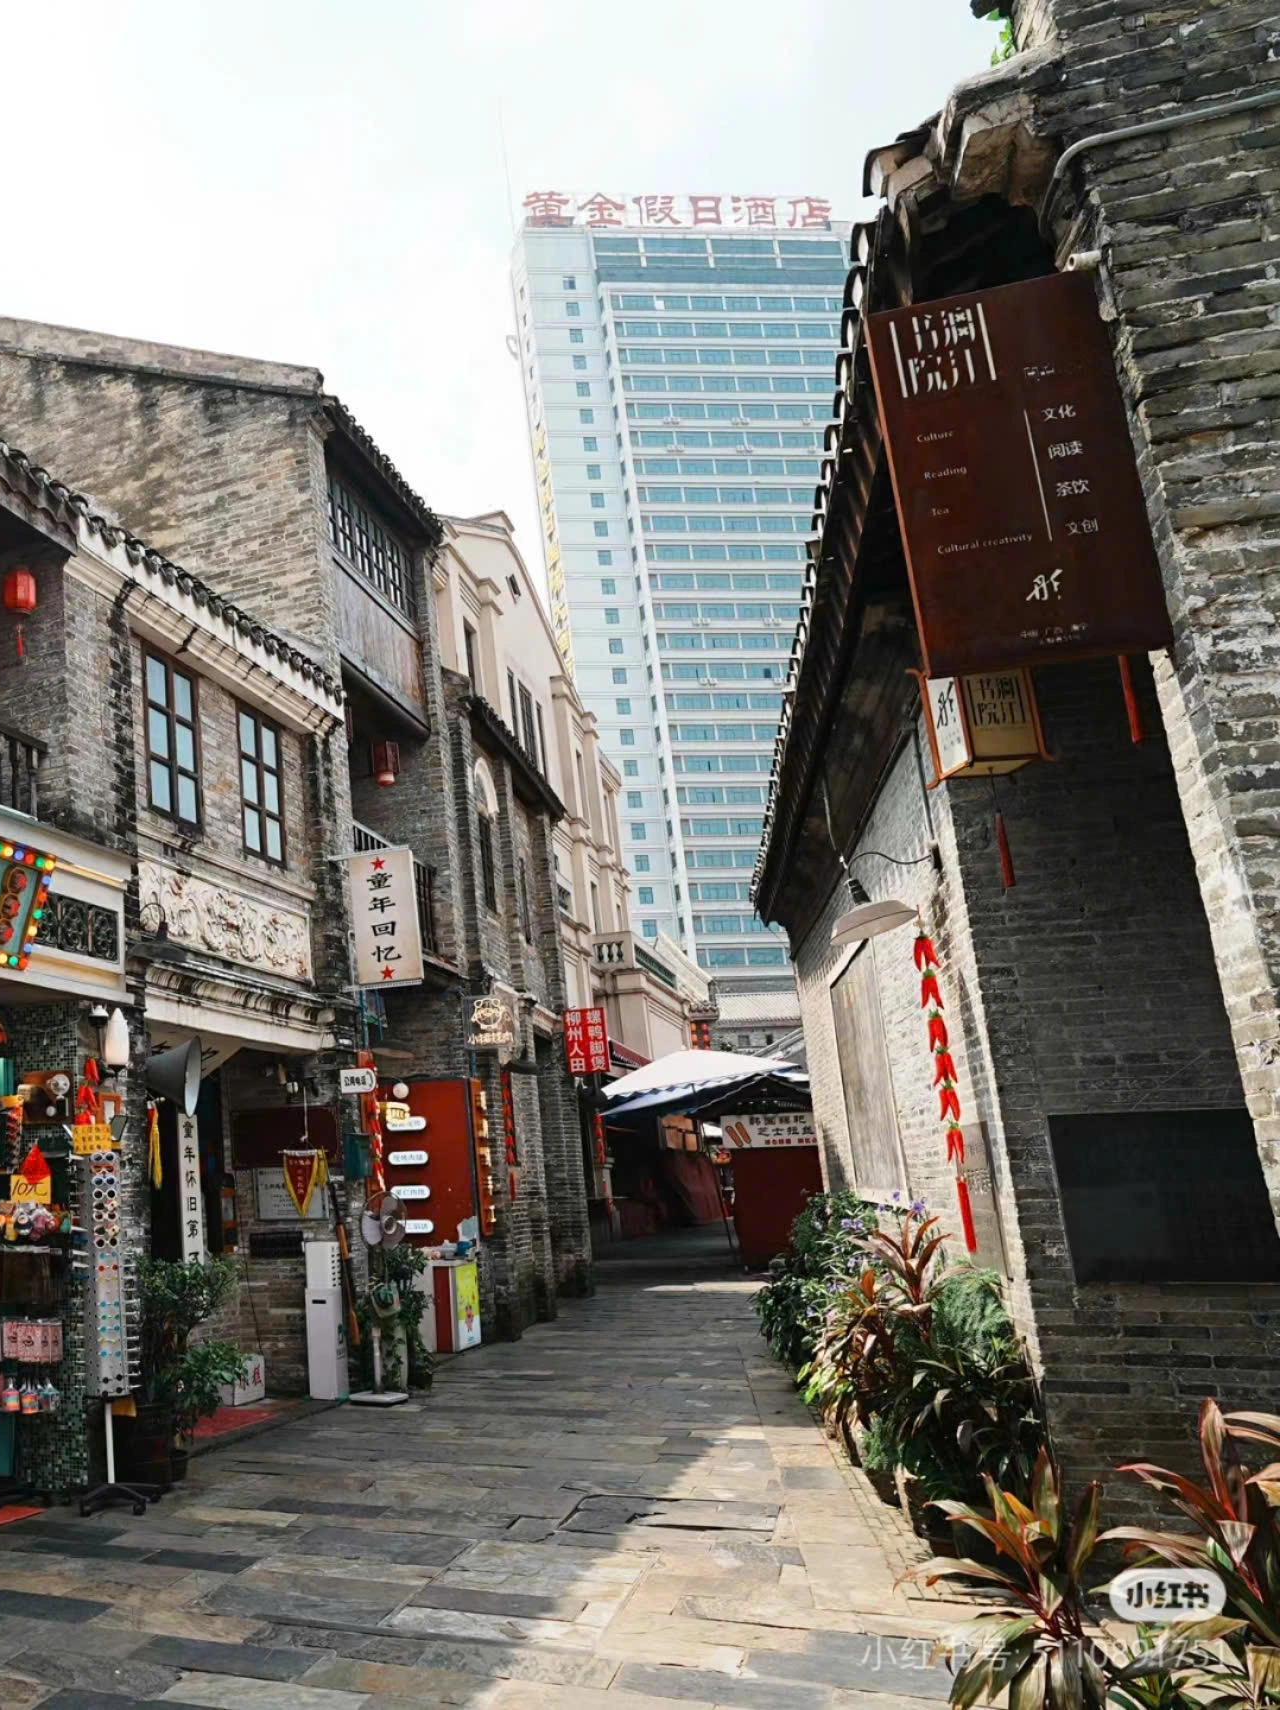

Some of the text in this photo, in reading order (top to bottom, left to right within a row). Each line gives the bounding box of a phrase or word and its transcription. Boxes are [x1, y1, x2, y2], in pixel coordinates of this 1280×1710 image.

[522, 190, 831, 228] 黄金假日酒店
[1041, 403, 1077, 422] 文化
[916, 429, 955, 444] Culture
[1047, 440, 1085, 460] 阅读
[923, 464, 968, 481] Reading
[1055, 478, 1091, 498] 茶饮
[931, 505, 951, 517] Tea
[1065, 517, 1099, 537] 文创
[937, 531, 1034, 556] Cultural creativity
[366, 872, 402, 963] 童年回忆
